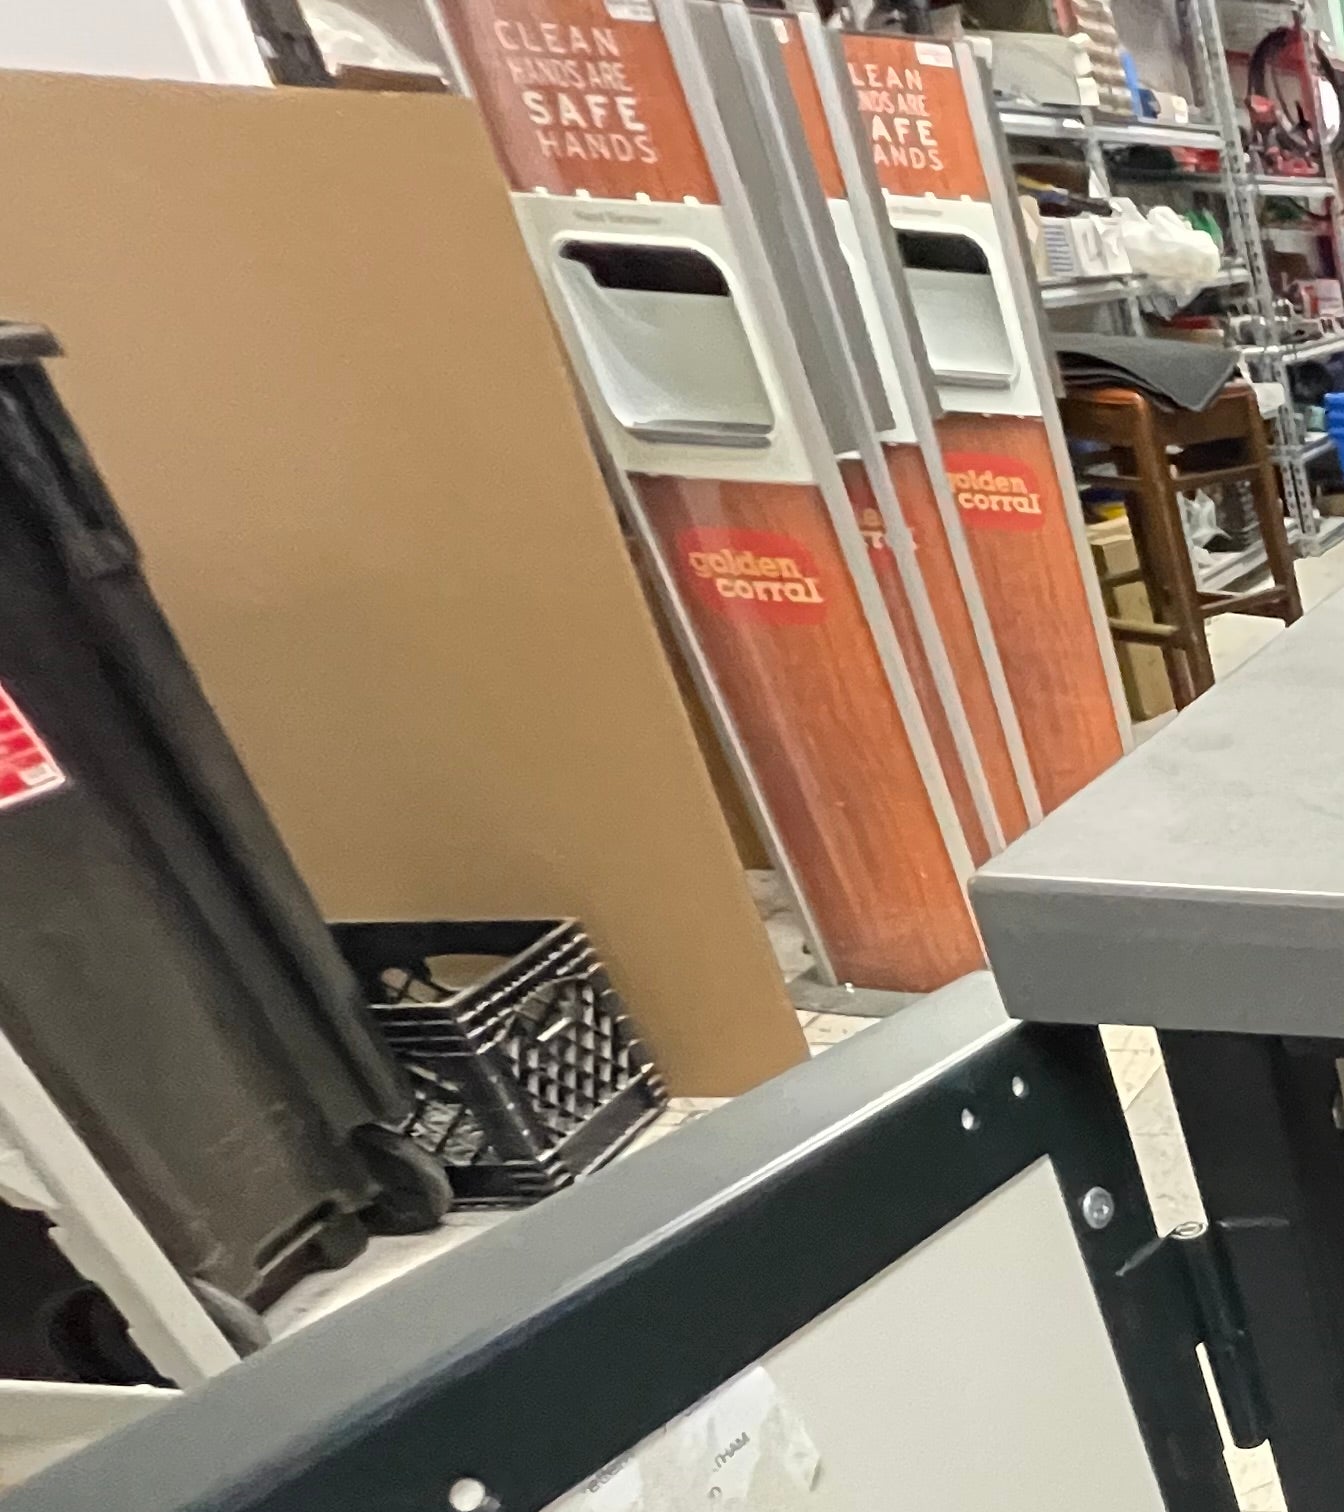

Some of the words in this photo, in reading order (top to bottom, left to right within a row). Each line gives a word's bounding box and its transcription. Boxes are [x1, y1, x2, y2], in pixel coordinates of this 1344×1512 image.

[493, 20, 621, 57] CLEAN
[506, 56, 586, 90] HANDS
[585, 60, 634, 92] ARE
[847, 61, 923, 91] LEAN
[521, 90, 647, 132] SAFE
[897, 92, 931, 117] ARE
[871, 114, 939, 146] AFE
[535, 129, 659, 164] HANDS
[873, 143, 945, 172] ANDS
[958, 492, 1042, 515] corral
[688, 548, 804, 579] golden
[715, 577, 824, 604] corral
